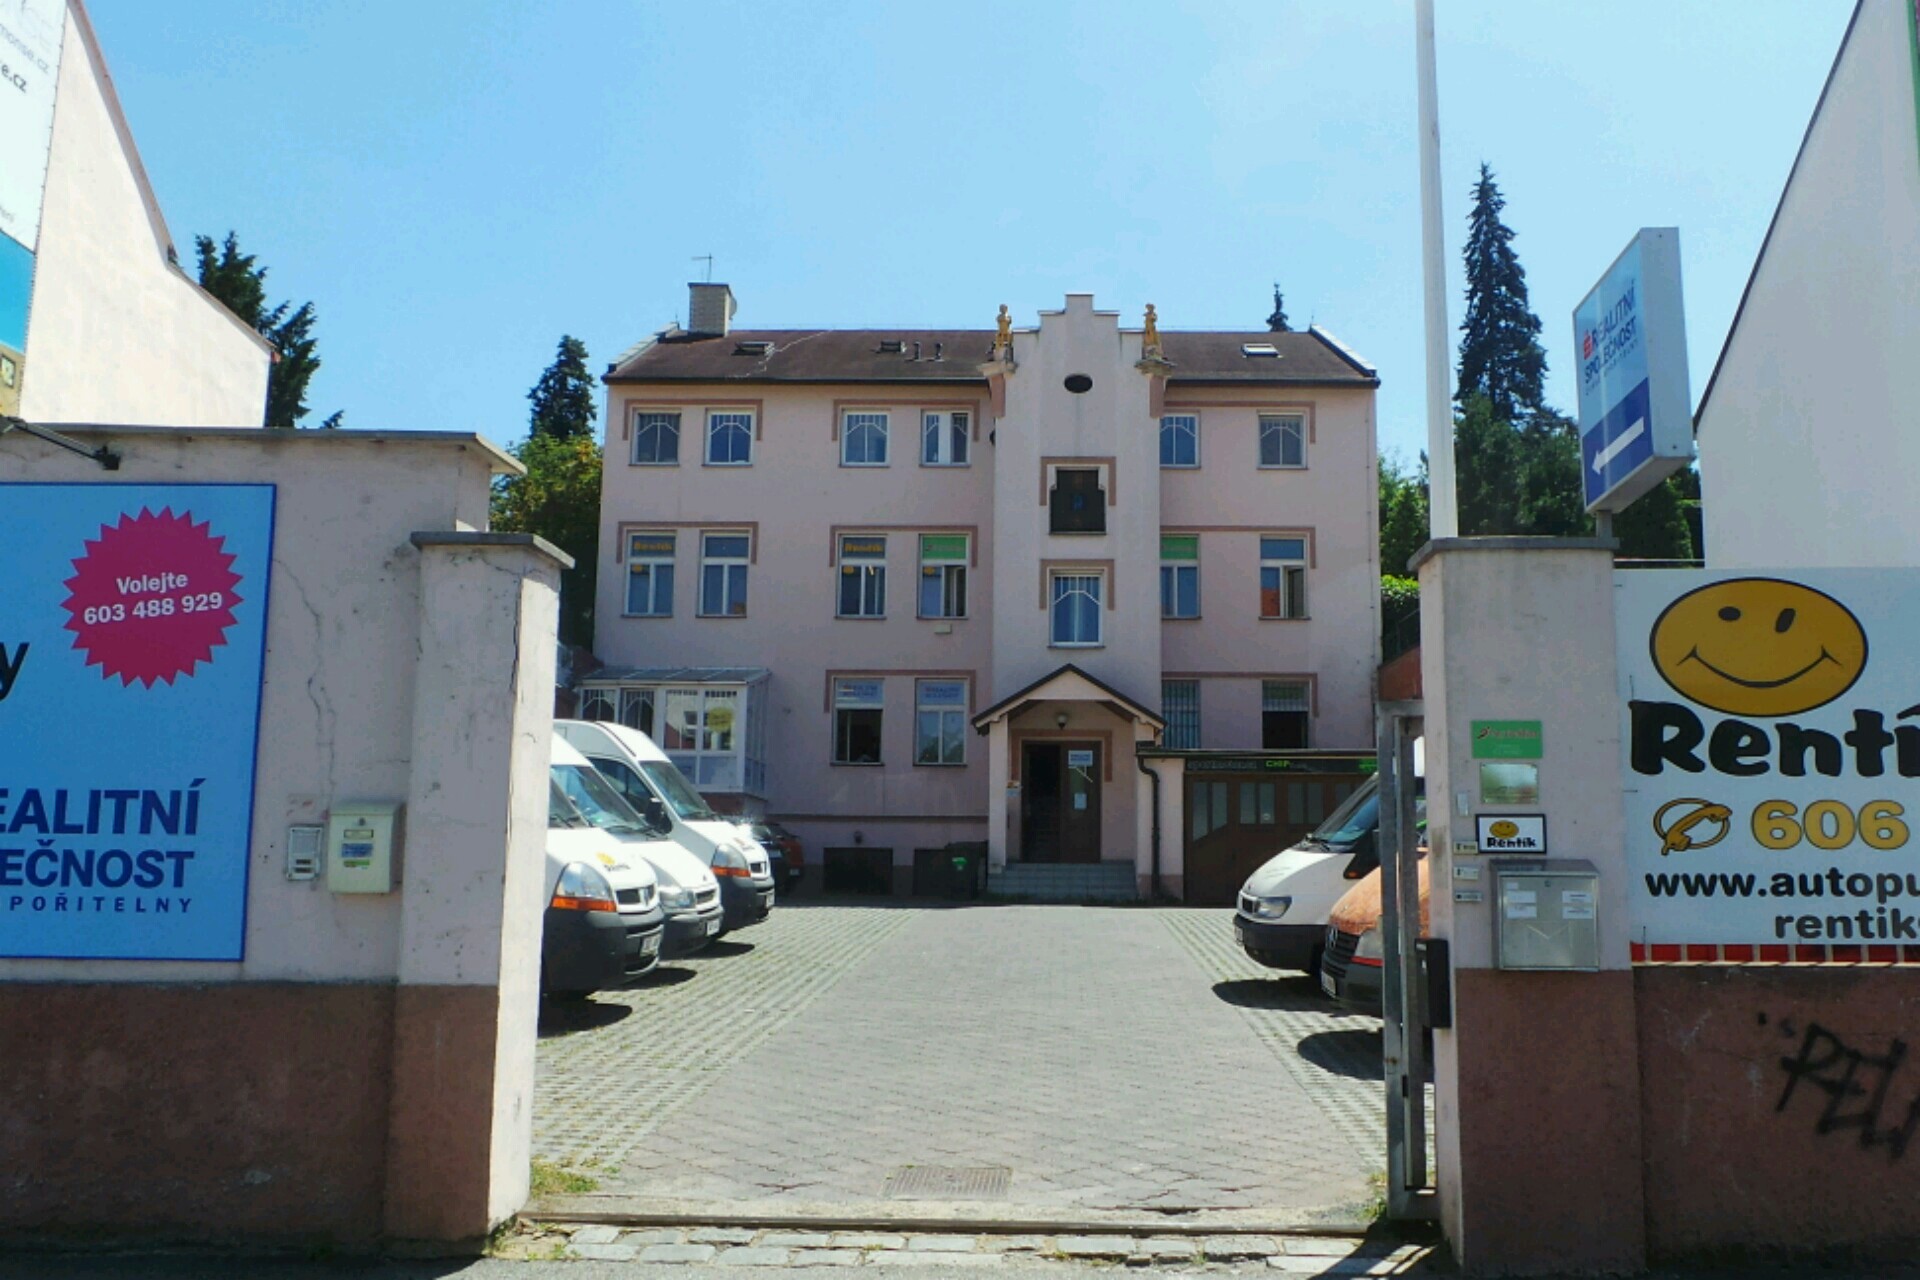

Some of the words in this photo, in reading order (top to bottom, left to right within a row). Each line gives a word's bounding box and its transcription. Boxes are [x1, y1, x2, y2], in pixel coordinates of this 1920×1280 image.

[0, 60, 26, 93] e.cz
[116, 572, 188, 595] Volejte
[83, 604, 126, 624] 603
[132, 597, 175, 619] 488
[181, 592, 223, 613] 929
[0, 777, 206, 836] ALITNÍ
[1751, 799, 1911, 850] 606
[9, 892, 192, 913] POŘITELNY
[1775, 906, 1920, 939] rentik
